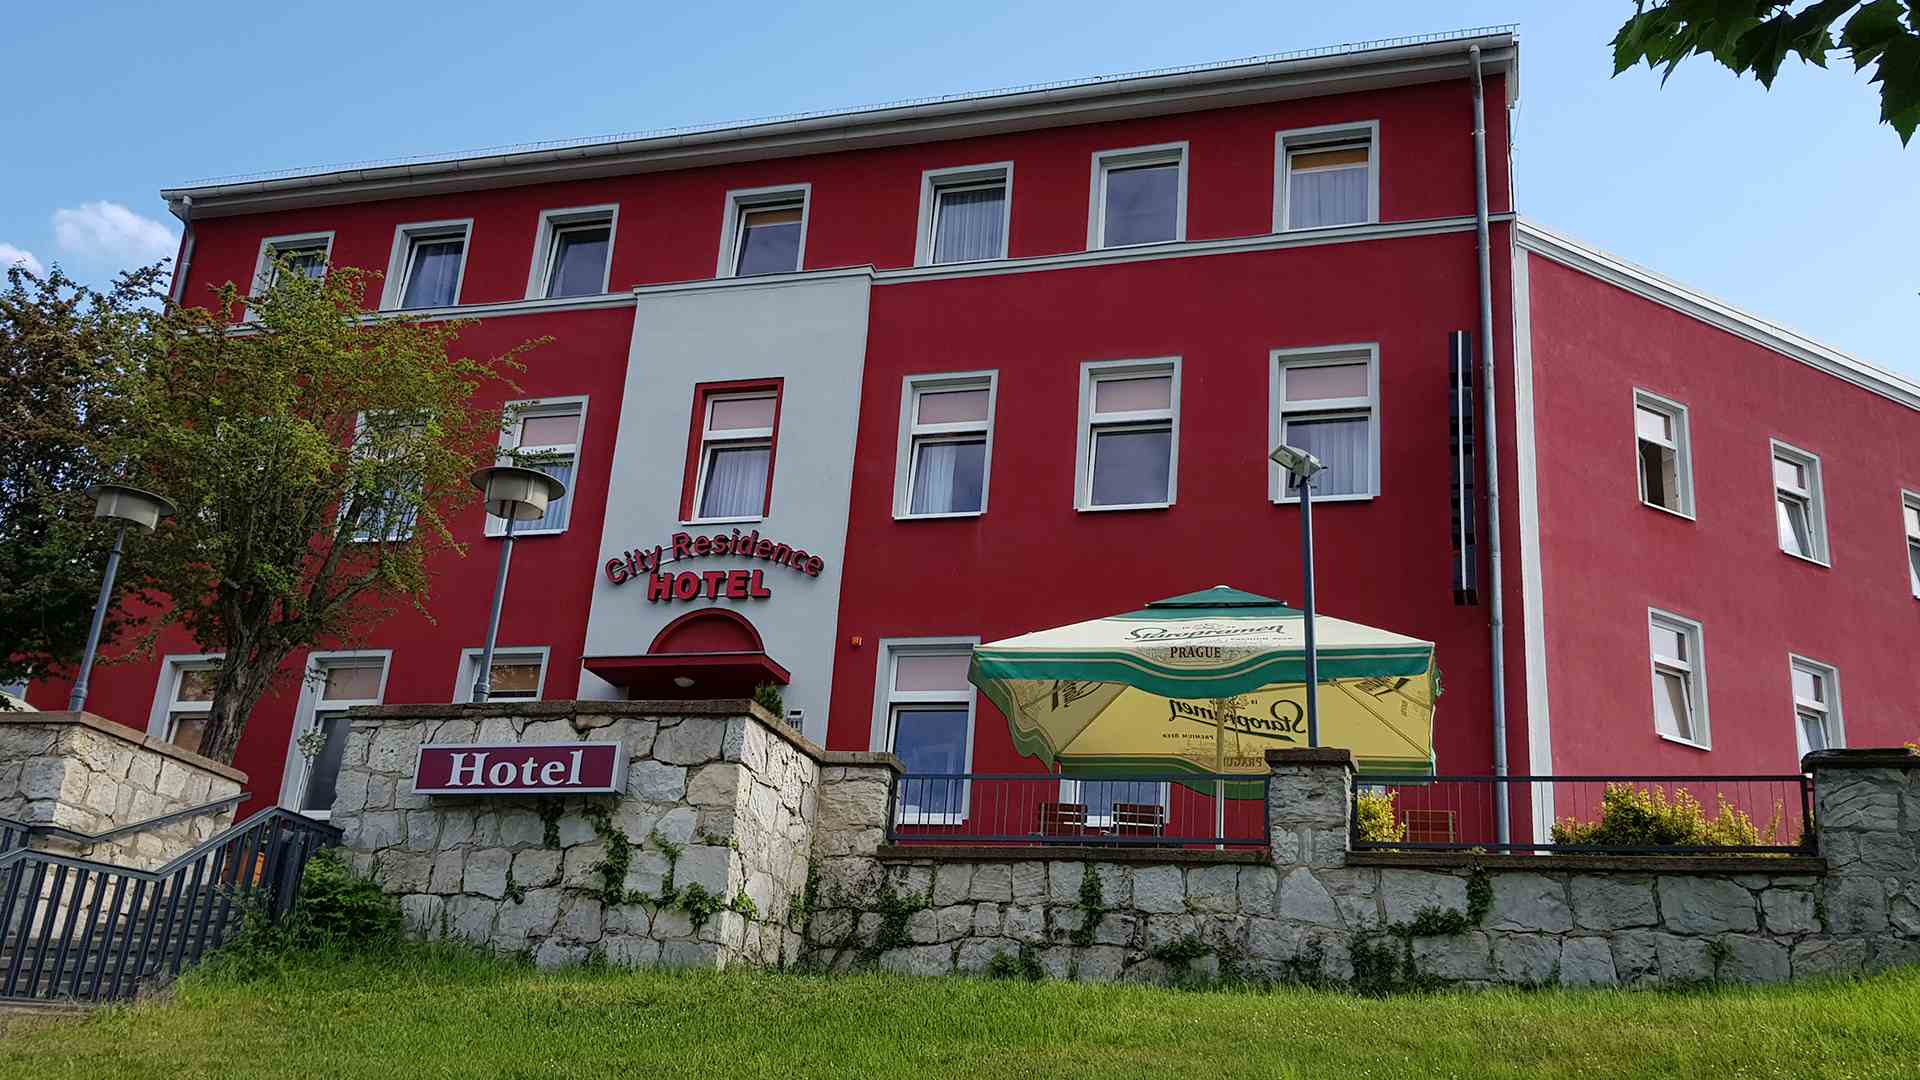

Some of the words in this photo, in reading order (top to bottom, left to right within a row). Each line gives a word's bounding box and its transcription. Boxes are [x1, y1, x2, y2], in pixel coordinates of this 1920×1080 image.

[604, 545, 663, 585] City
[671, 528, 825, 578] Residence
[647, 569, 771, 602] HOTEL
[1124, 624, 1286, 642] Staropramen
[1169, 646, 1222, 659] PRAGUE
[445, 749, 584, 787] Hotel
